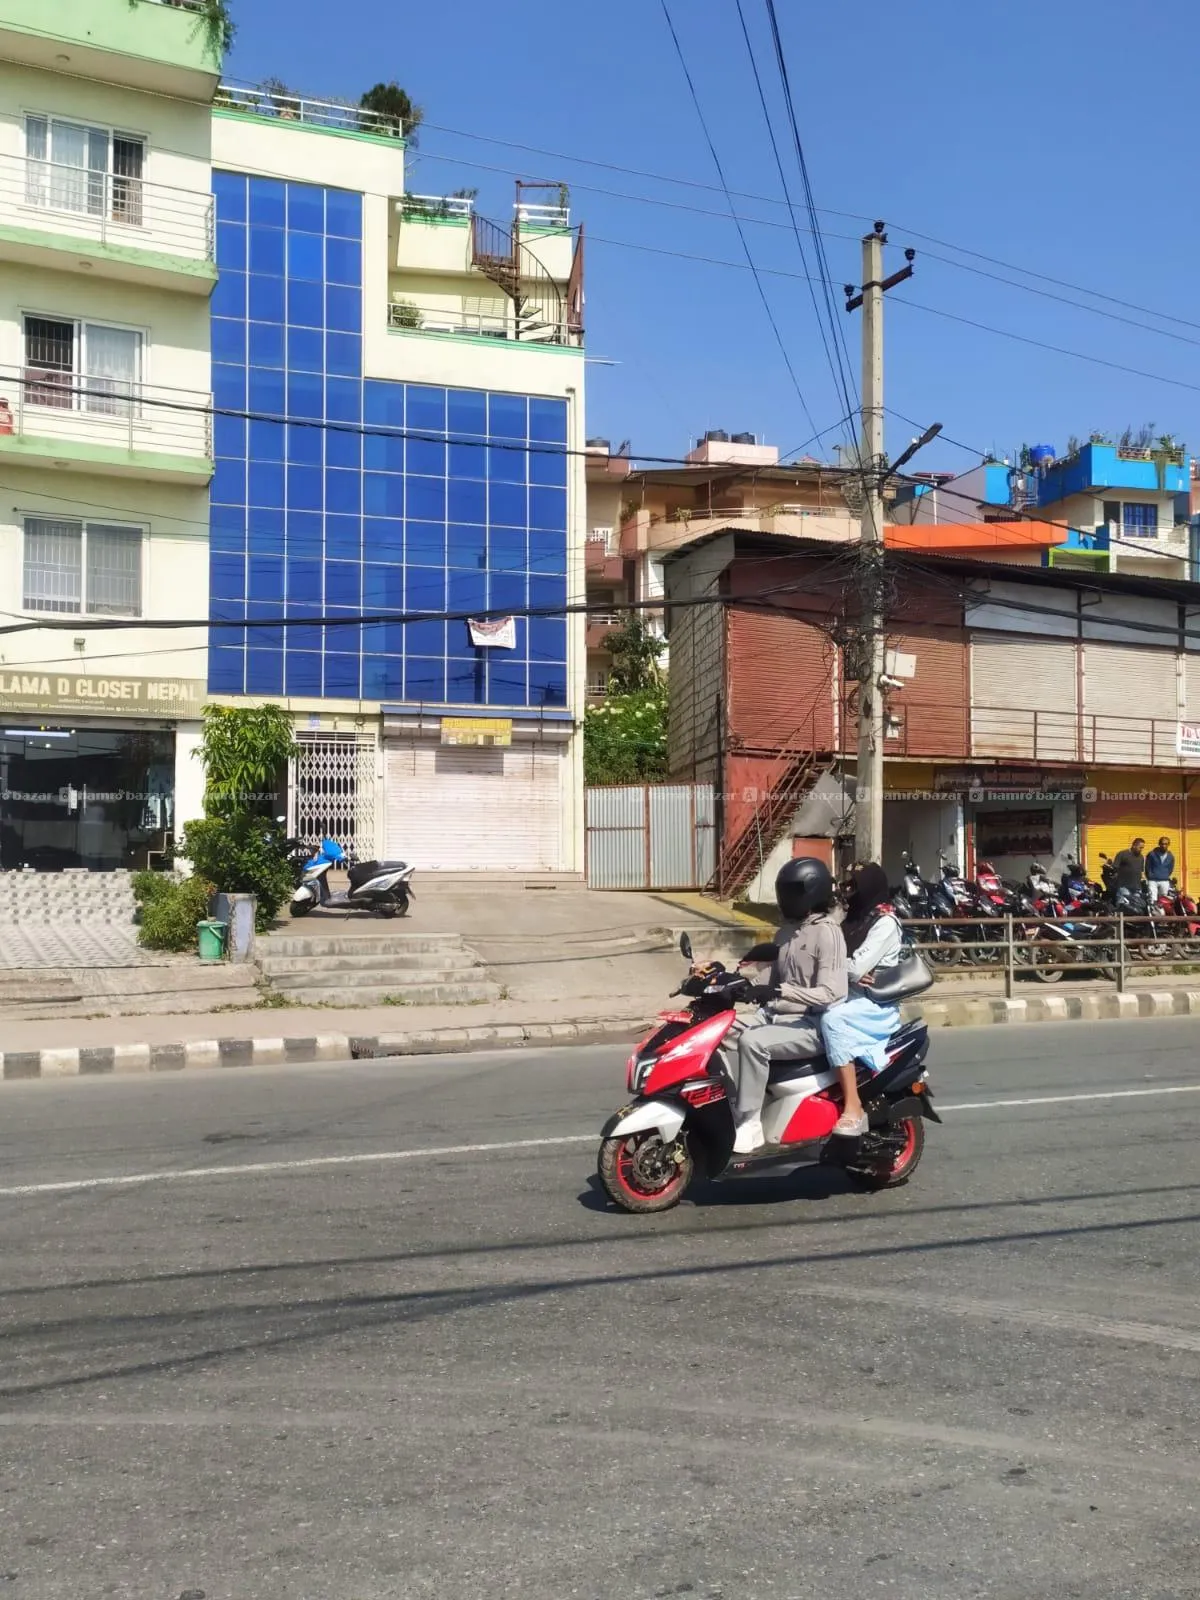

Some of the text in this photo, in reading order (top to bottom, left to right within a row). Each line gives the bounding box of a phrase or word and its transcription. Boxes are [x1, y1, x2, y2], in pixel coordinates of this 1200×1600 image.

[0, 675, 199, 702] LAMA D CLOSET NEPAL
